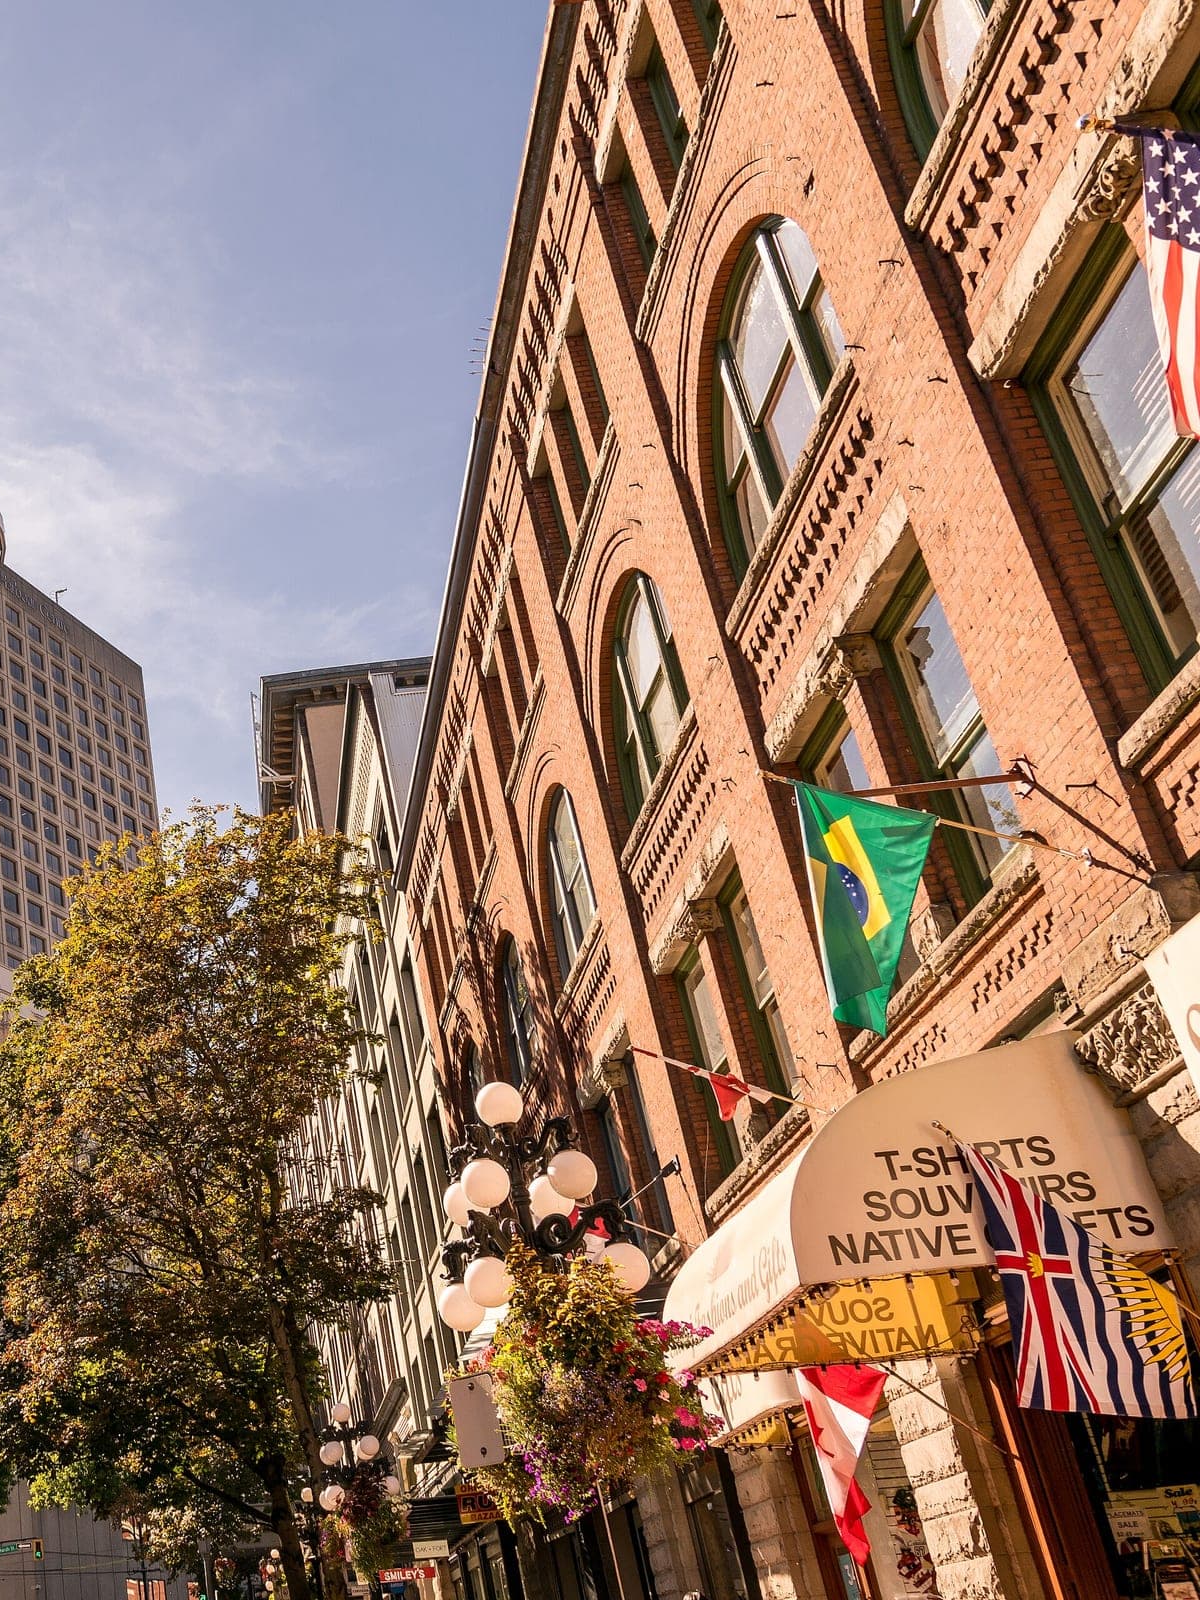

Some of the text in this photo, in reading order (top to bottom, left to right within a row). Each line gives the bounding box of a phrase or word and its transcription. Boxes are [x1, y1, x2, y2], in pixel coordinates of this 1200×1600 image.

[875, 1135, 1056, 1181] T-SHRTS
[863, 1171, 1097, 1222] SOUVIRS
[828, 1223, 977, 1266] NATIVE
[737, 1255, 760, 1309] and
[758, 1235, 787, 1304] Gifts
[461, 1493, 495, 1512] RU
[384, 1568, 425, 1581] SMILEY'S
